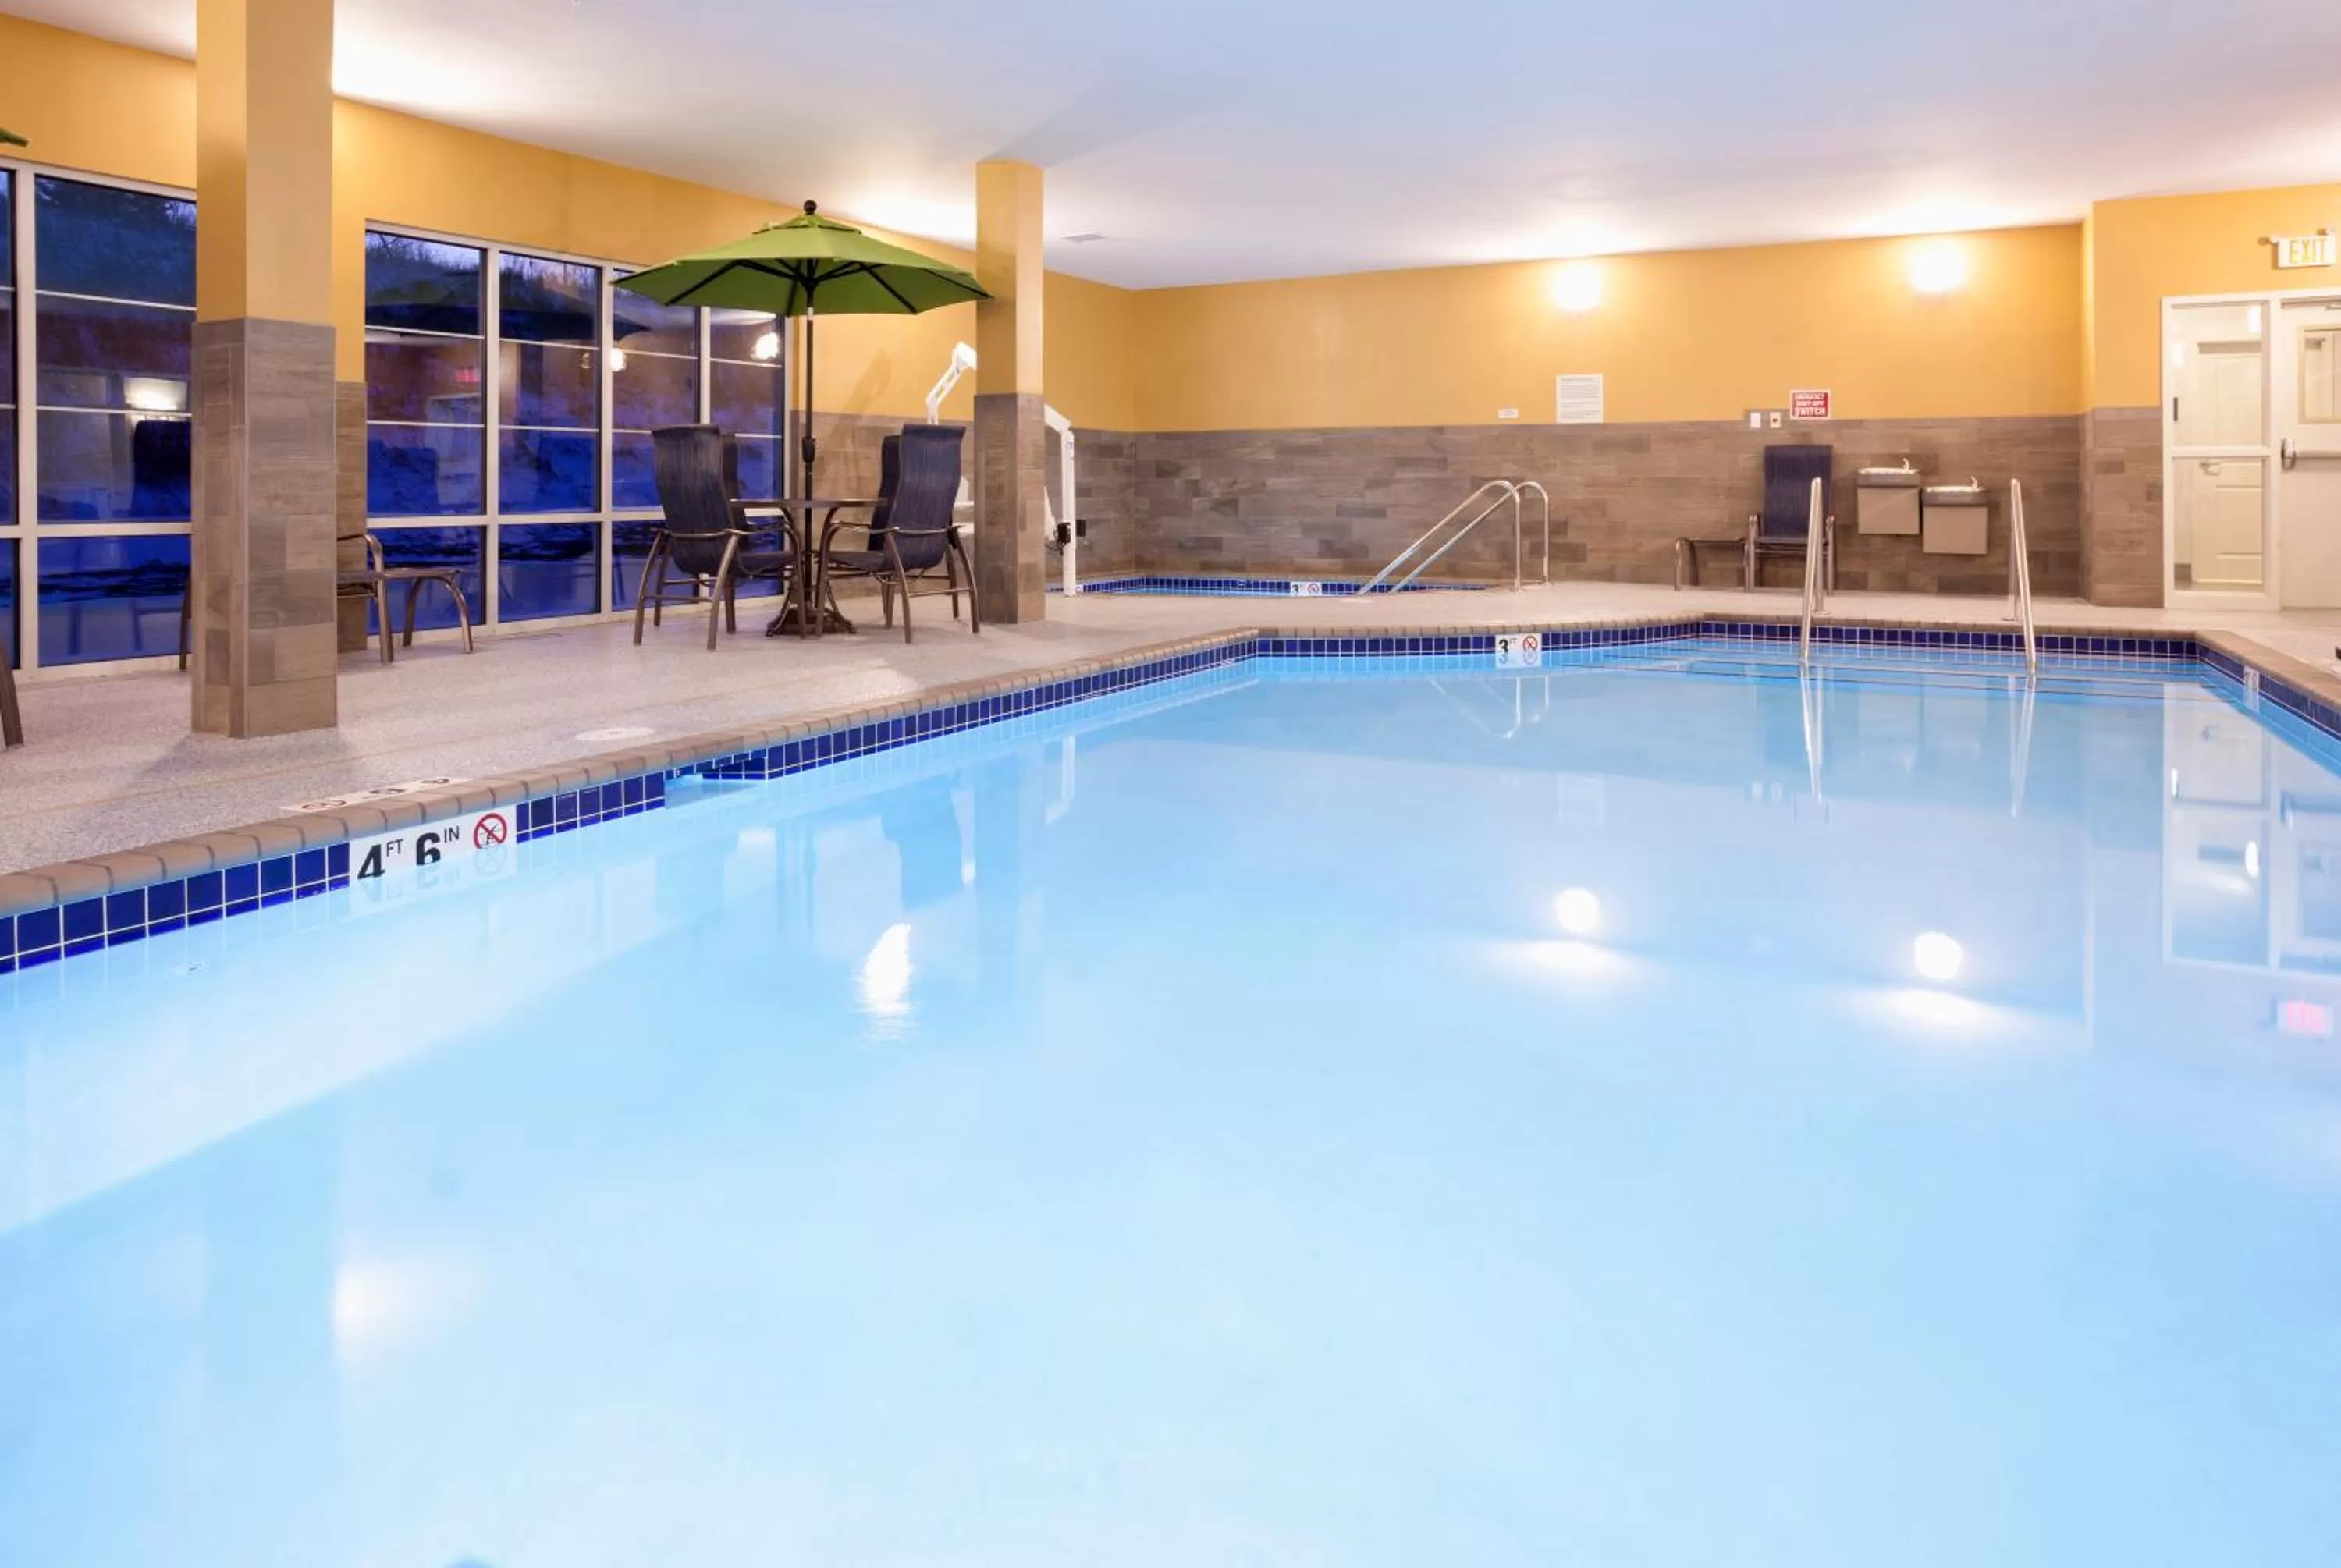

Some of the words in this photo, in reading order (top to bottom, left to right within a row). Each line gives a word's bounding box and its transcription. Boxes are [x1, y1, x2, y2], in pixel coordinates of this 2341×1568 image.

[2289, 239, 2329, 264] EXIT
[1794, 407, 1826, 416] SWITCH
[1498, 638, 1508, 653] 3
[357, 843, 385, 880] 4
[386, 839, 404, 857] FT
[416, 832, 441, 866] 6
[444, 825, 460, 843] IN
